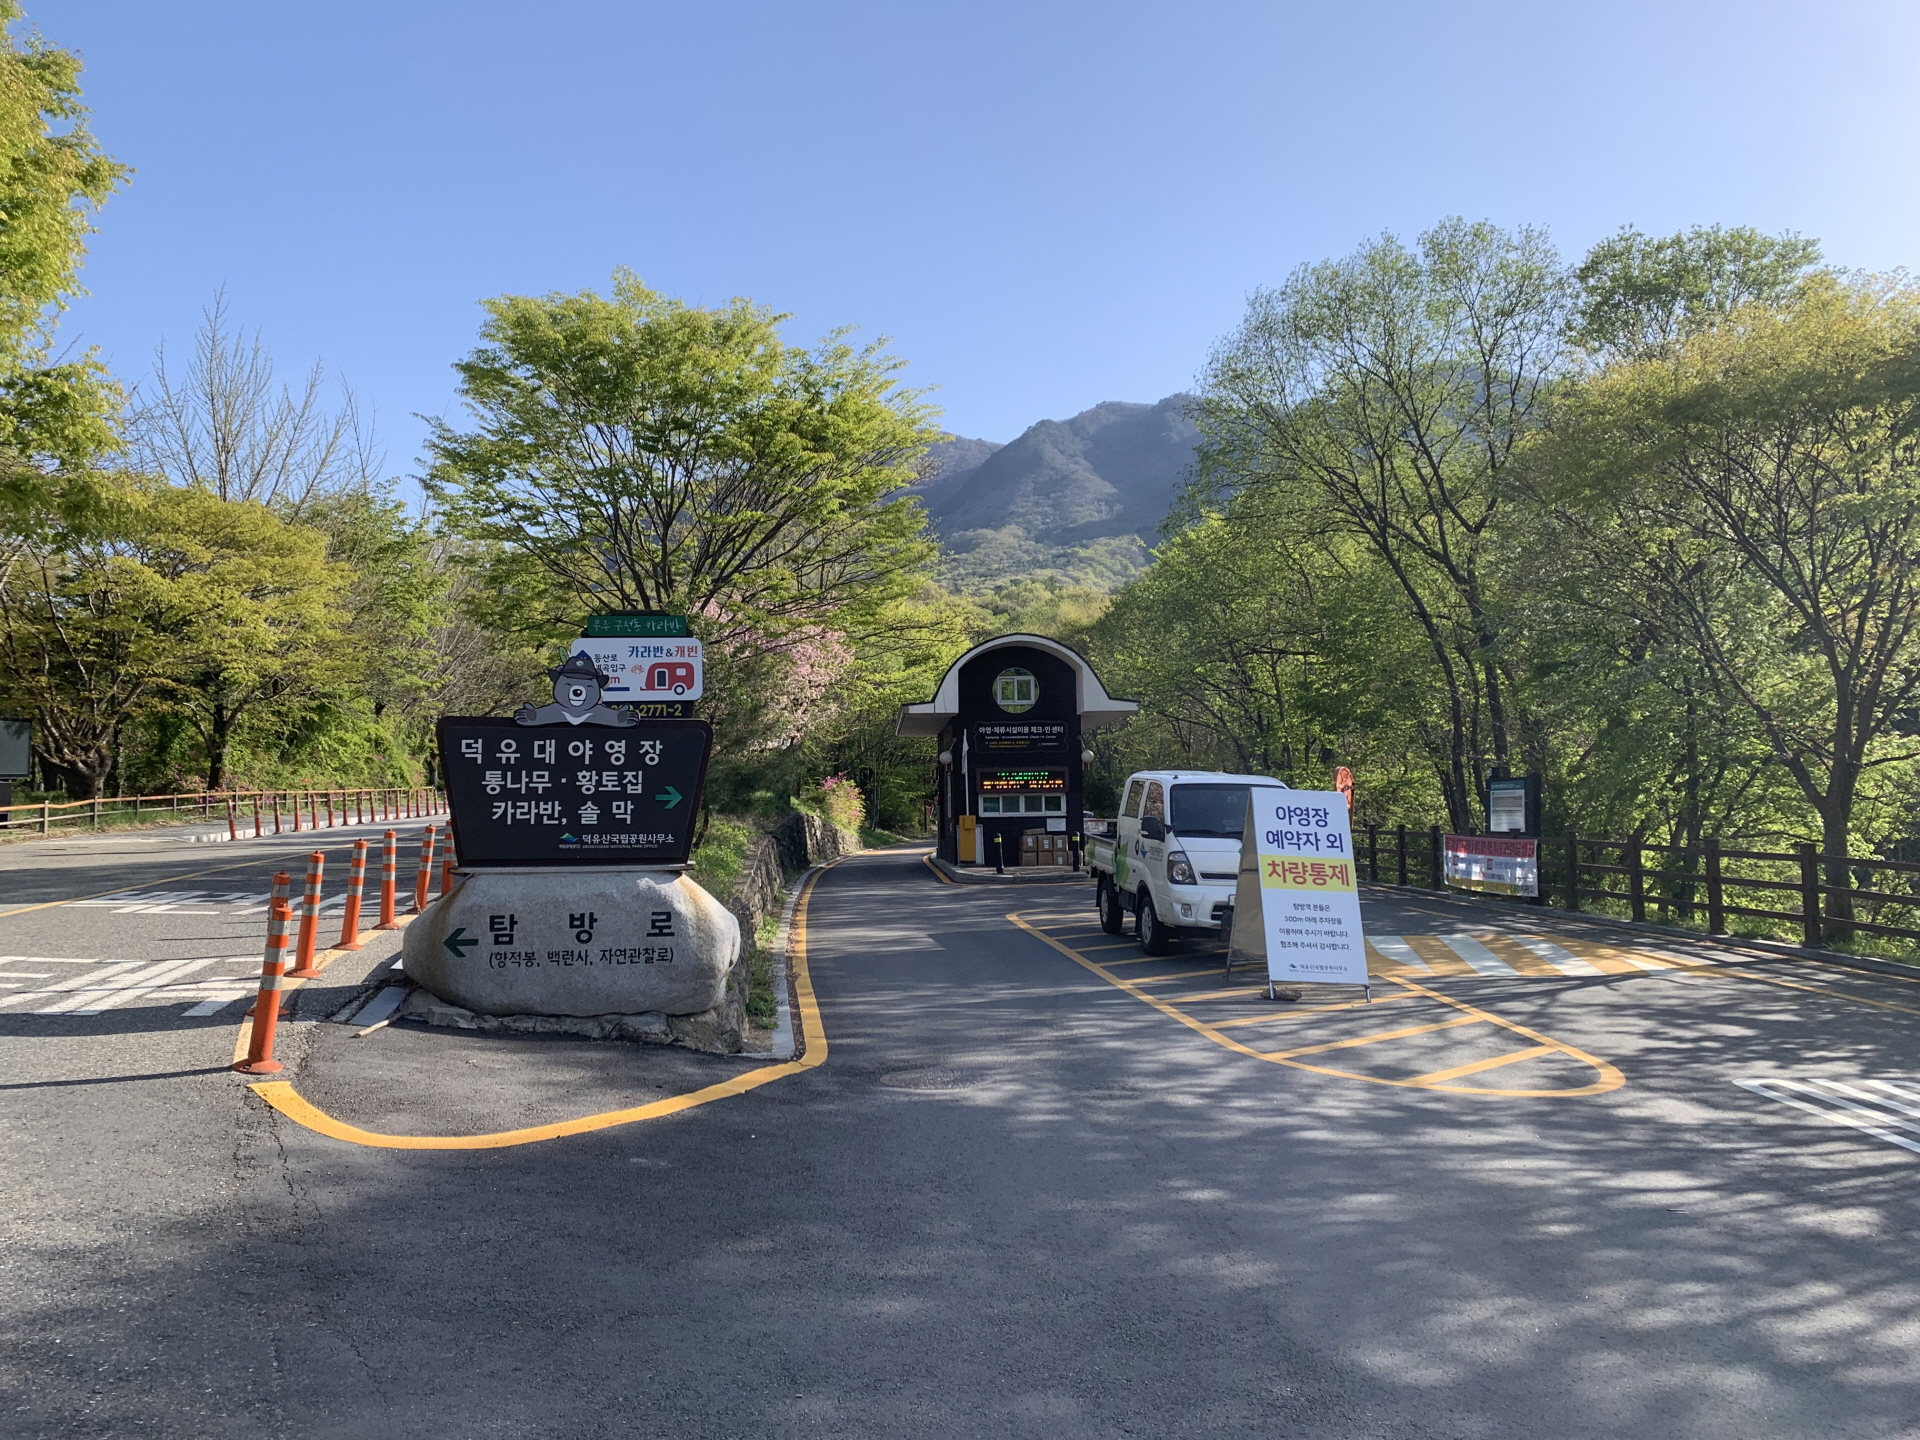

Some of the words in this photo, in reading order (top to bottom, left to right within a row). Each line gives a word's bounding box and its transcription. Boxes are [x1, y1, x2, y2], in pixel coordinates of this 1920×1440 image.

[593, 620, 611, 631] 무주
[614, 619, 641, 632] 구천동
[645, 619, 682, 632] 카라반
[593, 653, 618, 663] 등산로
[491, 801, 567, 825] 카라반,
[1275, 805, 1330, 828] 야영장
[582, 833, 675, 844] 덕유산국립공원사무소
[1265, 829, 1321, 852] 예약자
[1326, 832, 1344, 853] 외
[1267, 860, 1350, 887] 차량통제
[1293, 903, 1312, 911] 탐방객
[1312, 904, 1331, 912] 분들은
[1279, 928, 1303, 936] 이용하여
[1304, 929, 1323, 937] 주시기
[1323, 930, 1351, 938] 바랍니다.
[1280, 940, 1299, 948] 협조해
[1300, 941, 1318, 949] 주셔서
[1319, 942, 1352, 951] 감사합니다.
[489, 951, 541, 969] (향적봉,
[547, 949, 593, 967] 백련사,
[600, 947, 674, 965] 자연관찰로)
